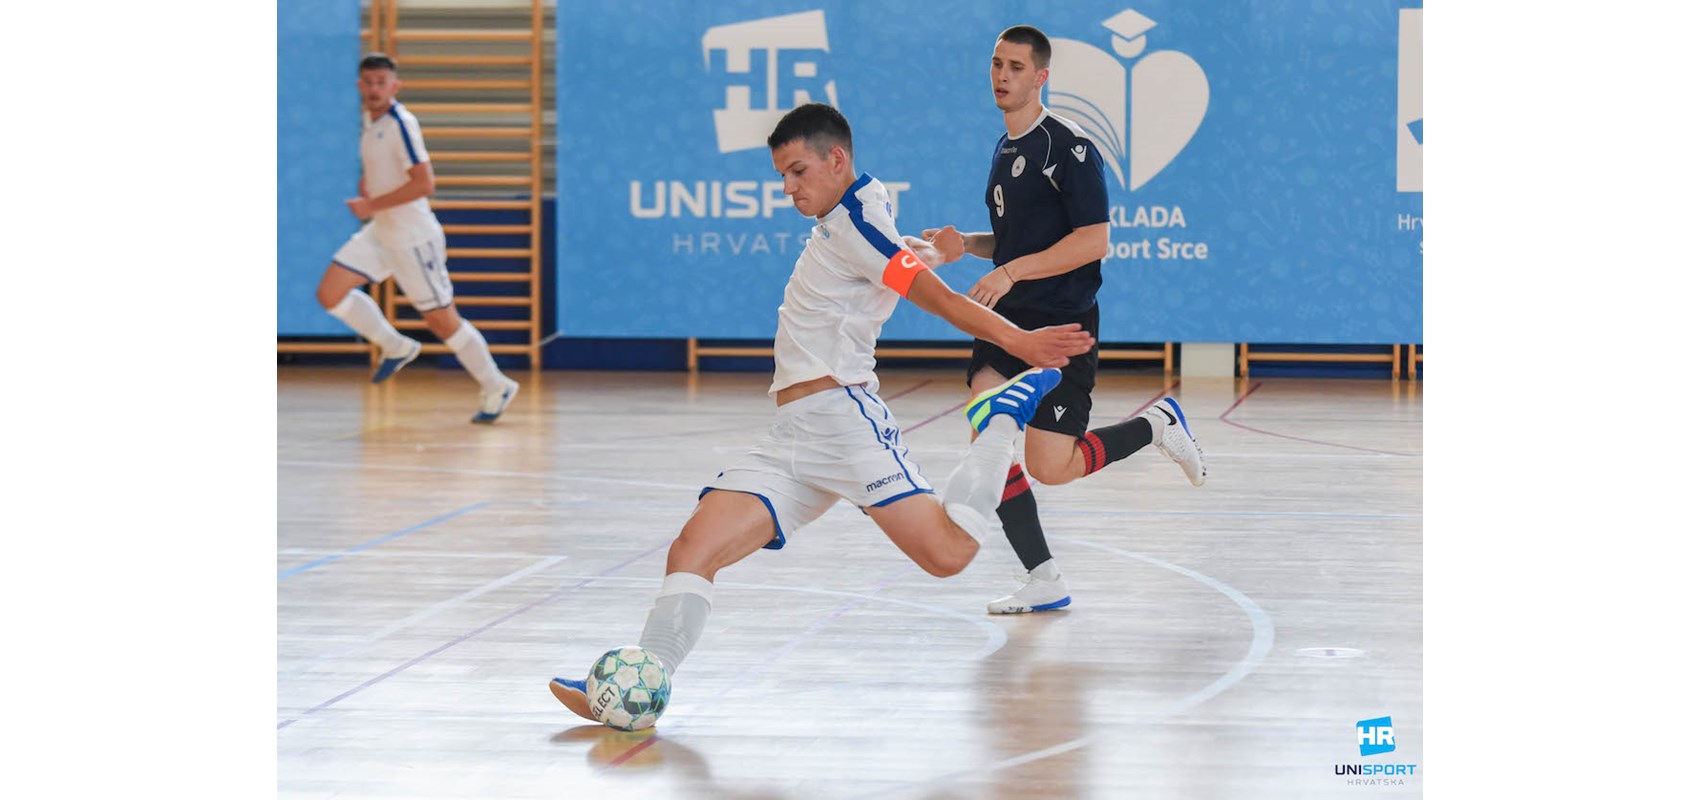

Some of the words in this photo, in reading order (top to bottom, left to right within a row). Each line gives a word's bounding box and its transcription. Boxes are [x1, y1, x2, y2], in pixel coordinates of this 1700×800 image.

[706, 48, 838, 111] HR
[630, 180, 911, 219] UNISPT
[993, 184, 1005, 218] 9
[673, 233, 812, 255] HRVAT
[1157, 238, 1208, 259] Srce
[900, 254, 918, 269] C
